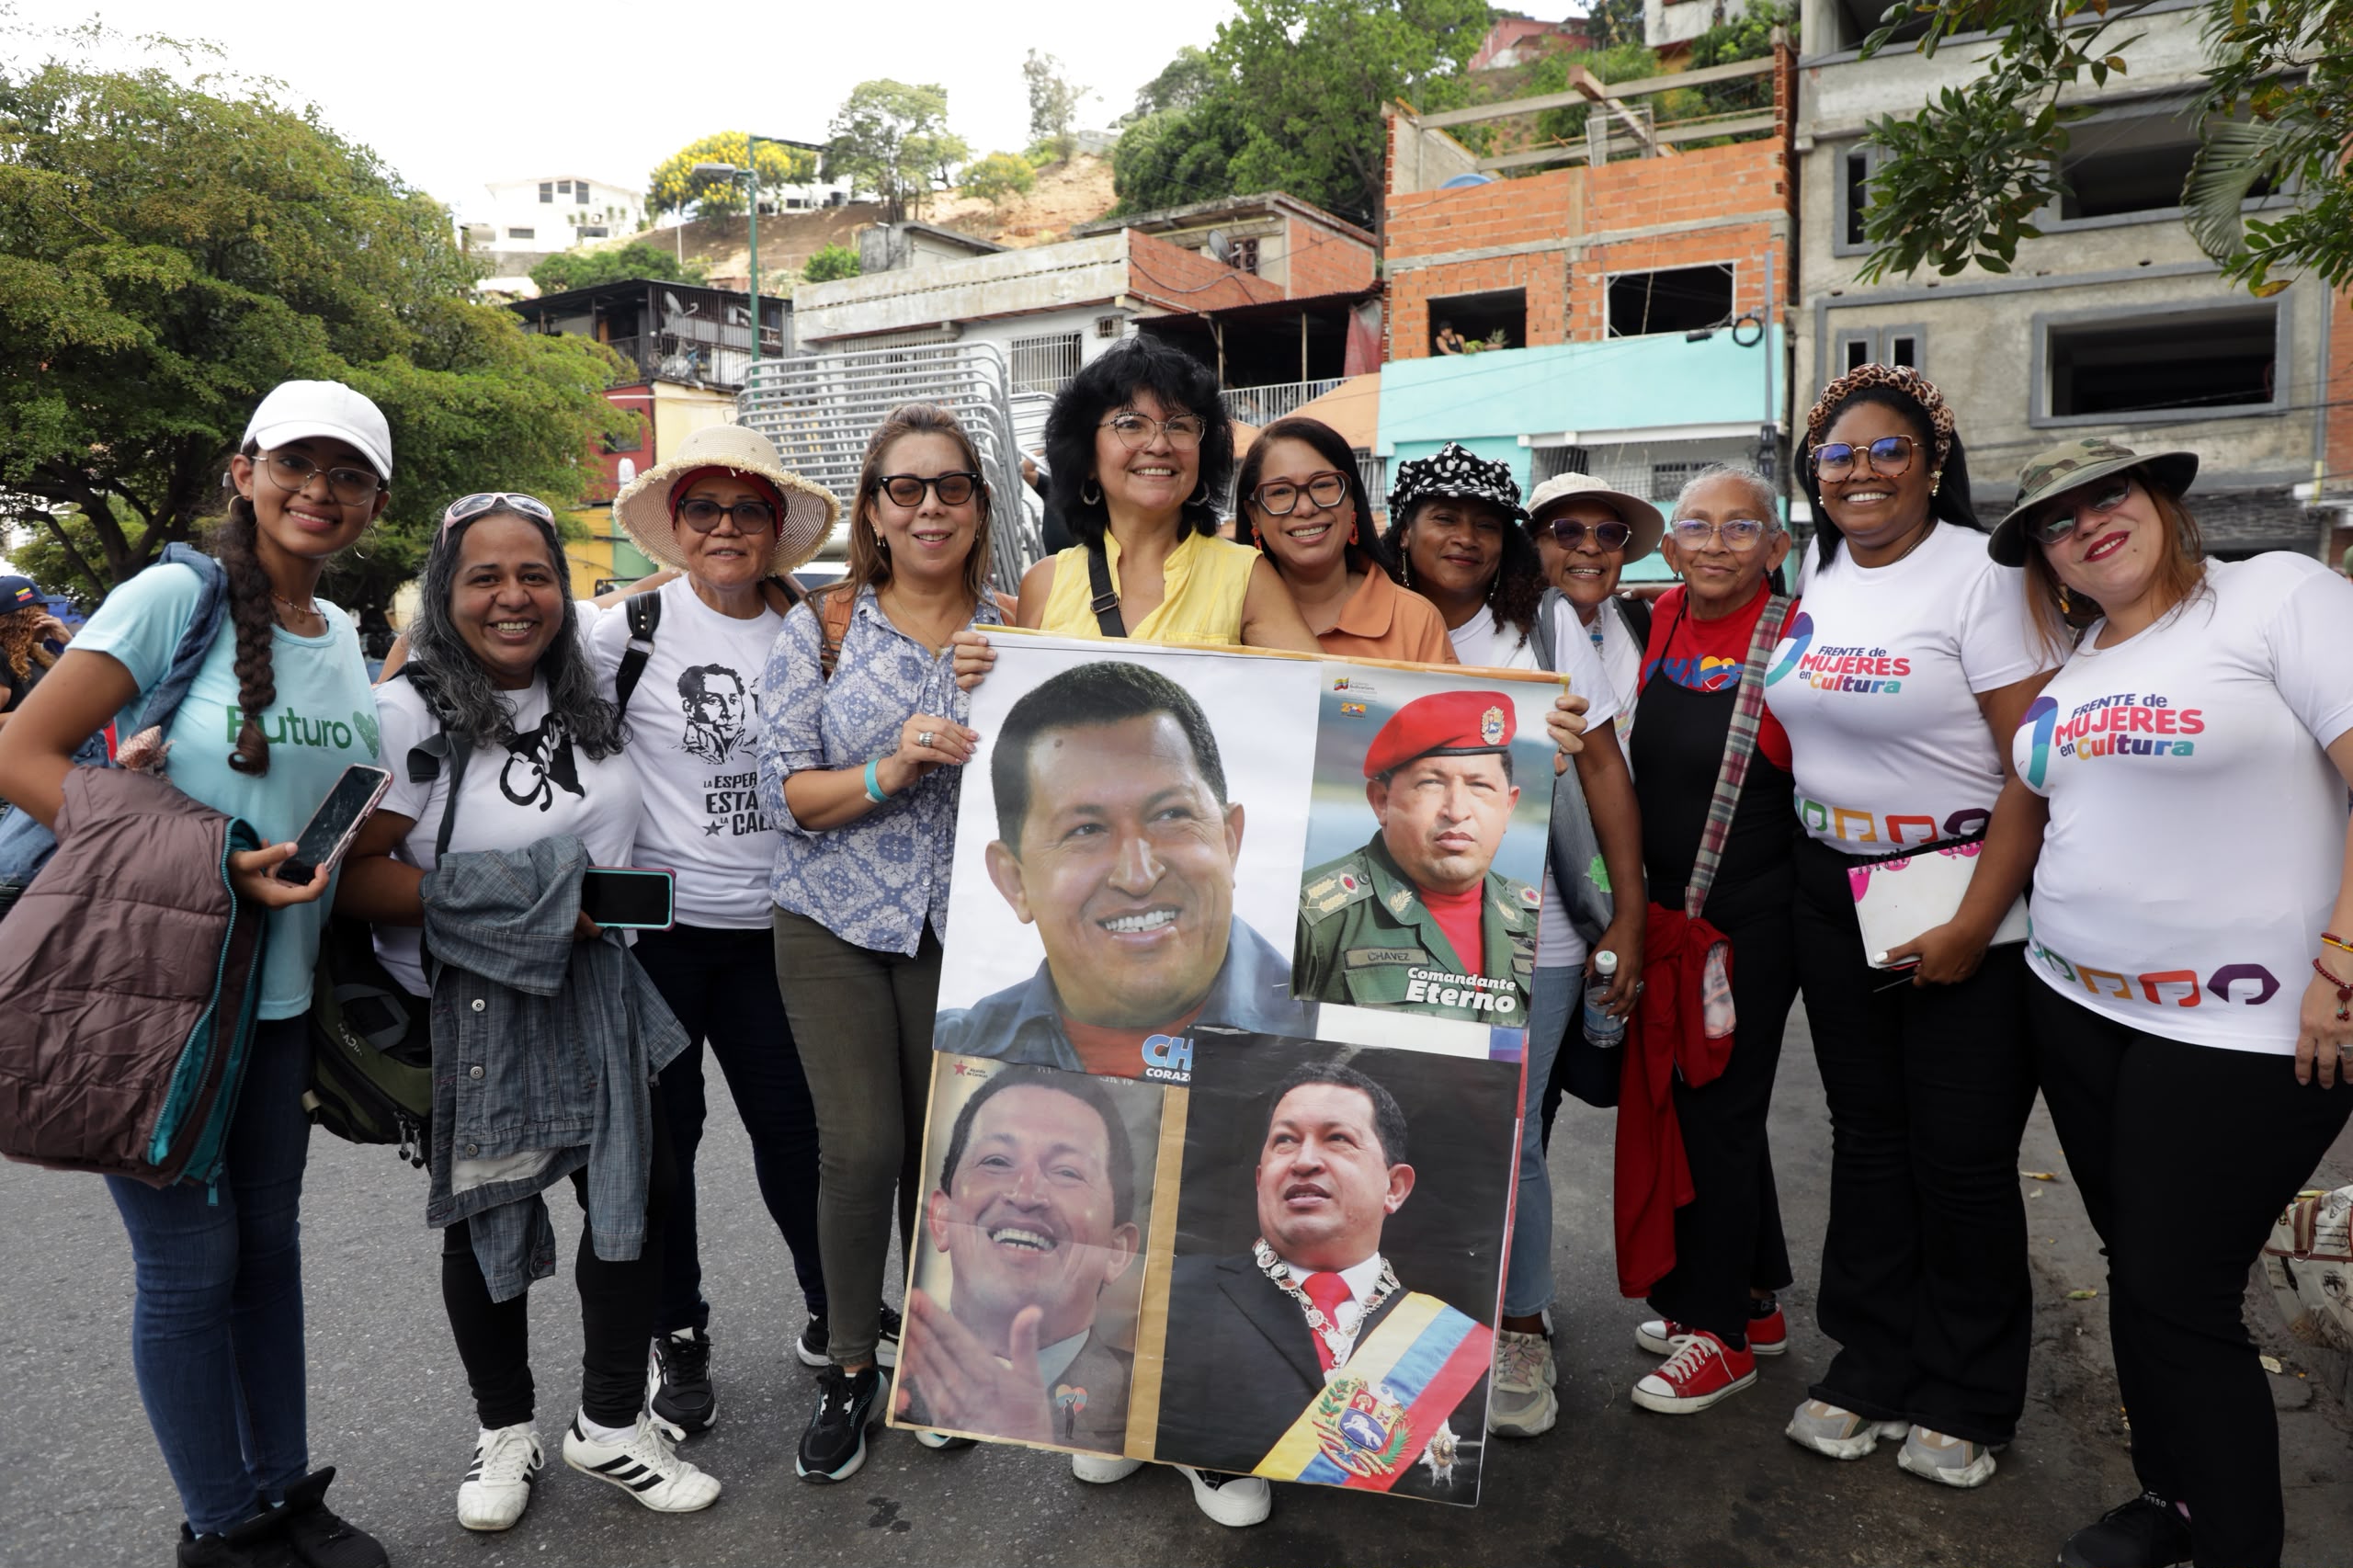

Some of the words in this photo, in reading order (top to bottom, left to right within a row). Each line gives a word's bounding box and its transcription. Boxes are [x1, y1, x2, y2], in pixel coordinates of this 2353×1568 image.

[1818, 645, 1865, 657] FRENTE
[1869, 647, 1886, 657] de
[1800, 653, 1911, 676] MUJERES
[1799, 670, 1812, 680] en
[1810, 673, 1902, 694] Cultura
[2071, 693, 2136, 720] FRENTE
[2143, 694, 2168, 708] de
[226, 705, 352, 749] Futuro
[2054, 706, 2205, 747] MUJERES
[2060, 742, 2075, 757] en
[2076, 733, 2195, 761] Cultura
[703, 780, 712, 789] LA
[714, 771, 758, 789] ESPER
[706, 785, 759, 814] ESTÁ
[720, 816, 729, 824] LA
[733, 812, 774, 836] CAL
[1368, 951, 1411, 961] CHAVEZ
[1407, 967, 1517, 991] Comandante
[1405, 980, 1517, 1013] Eterno
[1145, 1067, 1191, 1082] CORAZ
